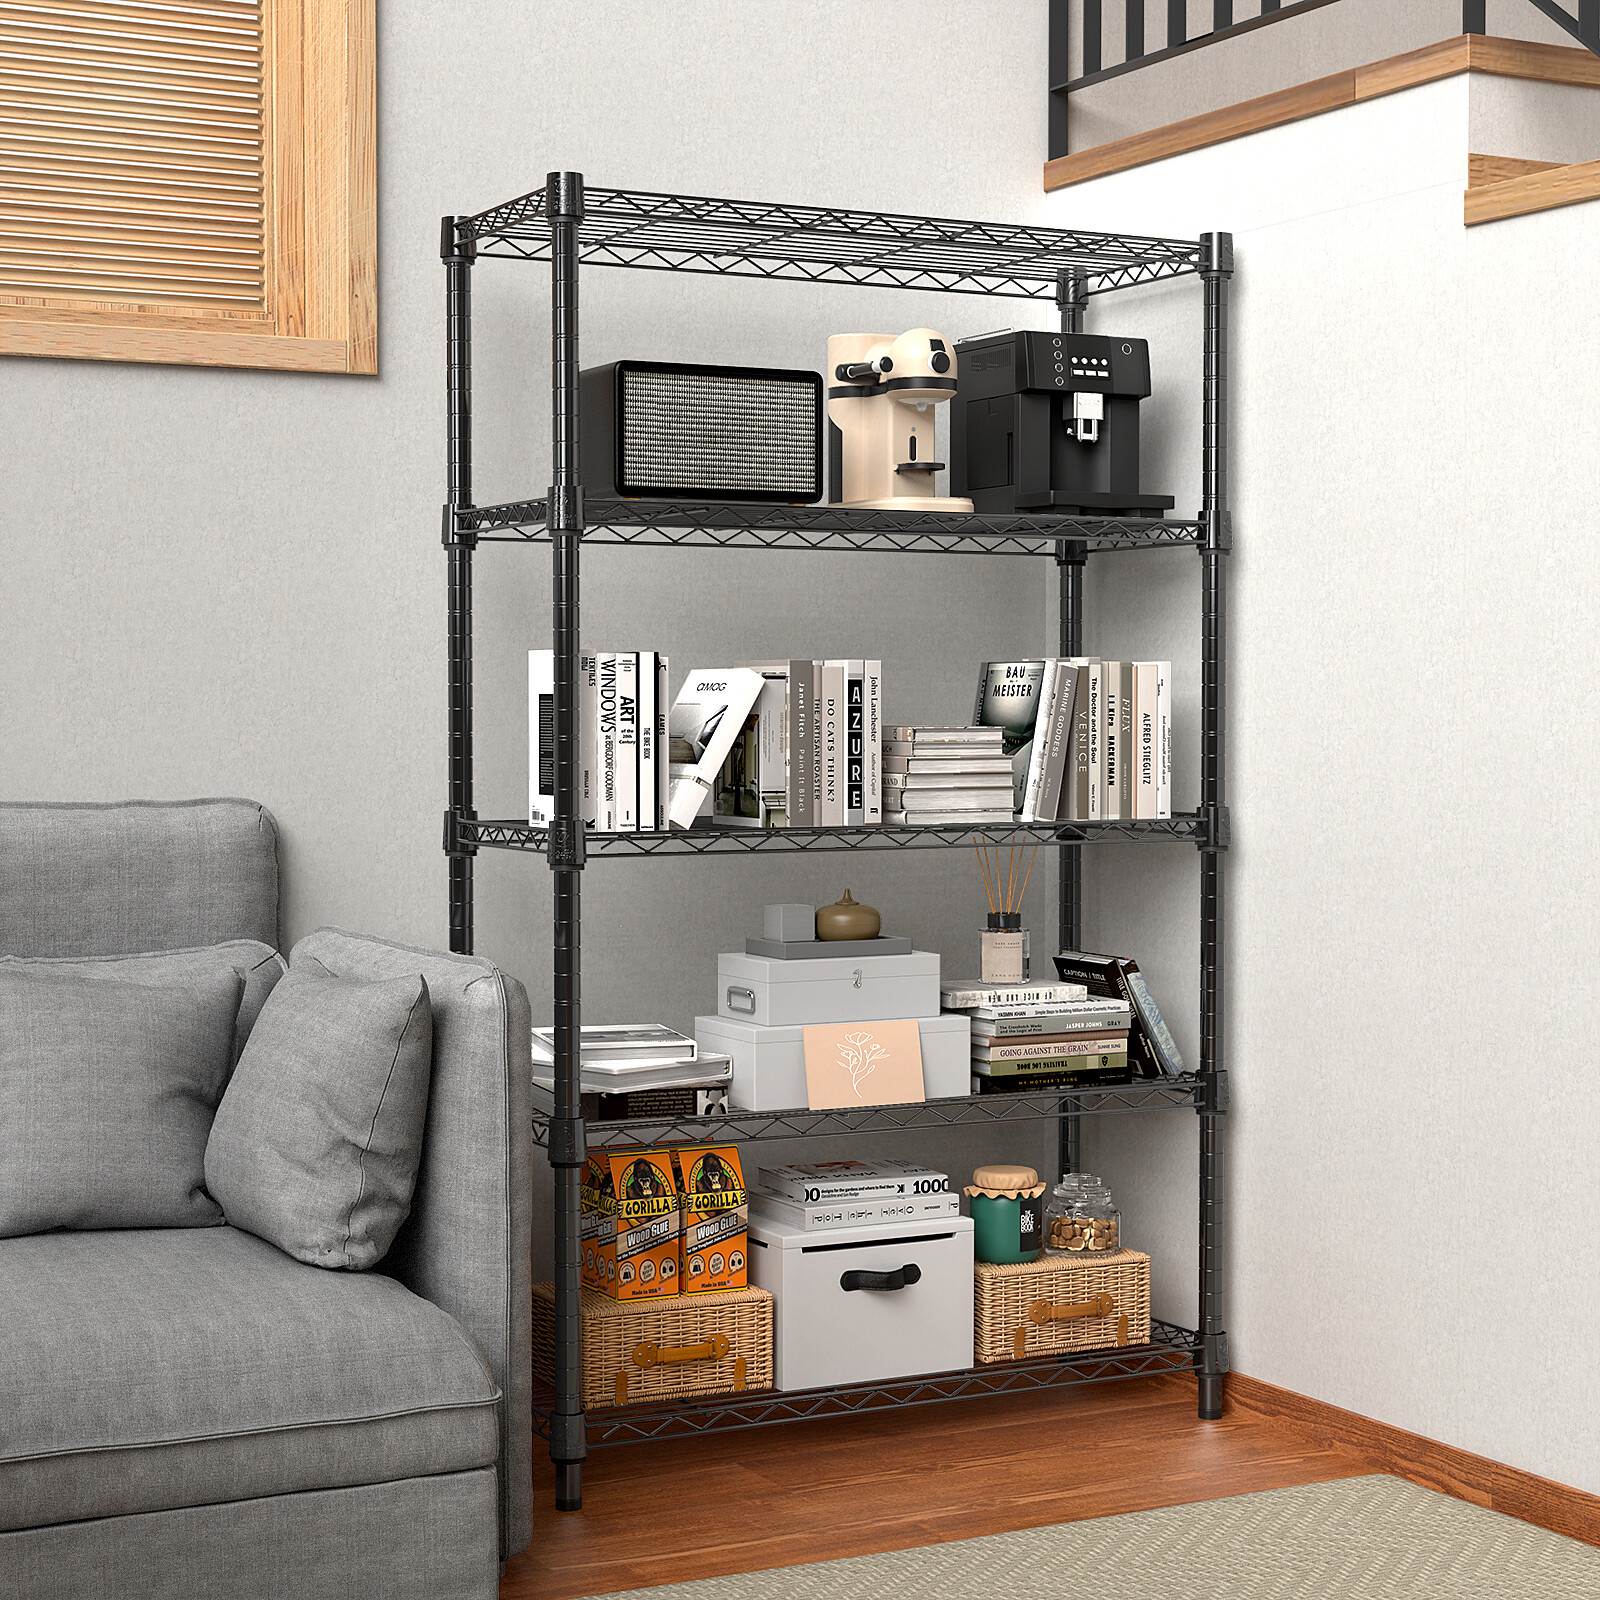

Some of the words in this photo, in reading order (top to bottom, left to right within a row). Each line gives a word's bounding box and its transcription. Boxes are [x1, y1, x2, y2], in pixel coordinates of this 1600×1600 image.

[588, 656, 596, 687] TEXTILES
[1006, 666, 1025, 678] BAU
[601, 659, 616, 733] WINDOWS
[870, 676, 878, 695] John
[993, 685, 1032, 697] MEISTER
[1060, 678, 1071, 713] MARINE
[620, 695, 634, 724] ART
[827, 699, 834, 716] DO
[1122, 698, 1130, 733] FLUX
[1052, 715, 1065, 758] GODDESS
[1079, 711, 1087, 772] VENICE
[1143, 713, 1151, 743] ALFRED
[605, 740, 613, 770] BERGDORF
[852, 686, 860, 807] AZURE
[1143, 746, 1151, 784] STIEGLITZ
[605, 770, 613, 801] GOODMAN
[1063, 968, 1087, 978] CAPTION
[1116, 976, 1126, 990] TITLE
[1000, 1048, 1022, 1057] GOING
[1023, 1046, 1052, 1056] AGAINST
[1053, 1045, 1066, 1054] THE
[1067, 1044, 1089, 1052] GRAIN
[1043, 1060, 1067, 1068] TRAINING
[655, 1169, 670, 1193] STRONG
[723, 1163, 738, 1188] STRONG
[625, 1198, 670, 1215] GORILLA
[695, 1192, 739, 1209] GORILLA
